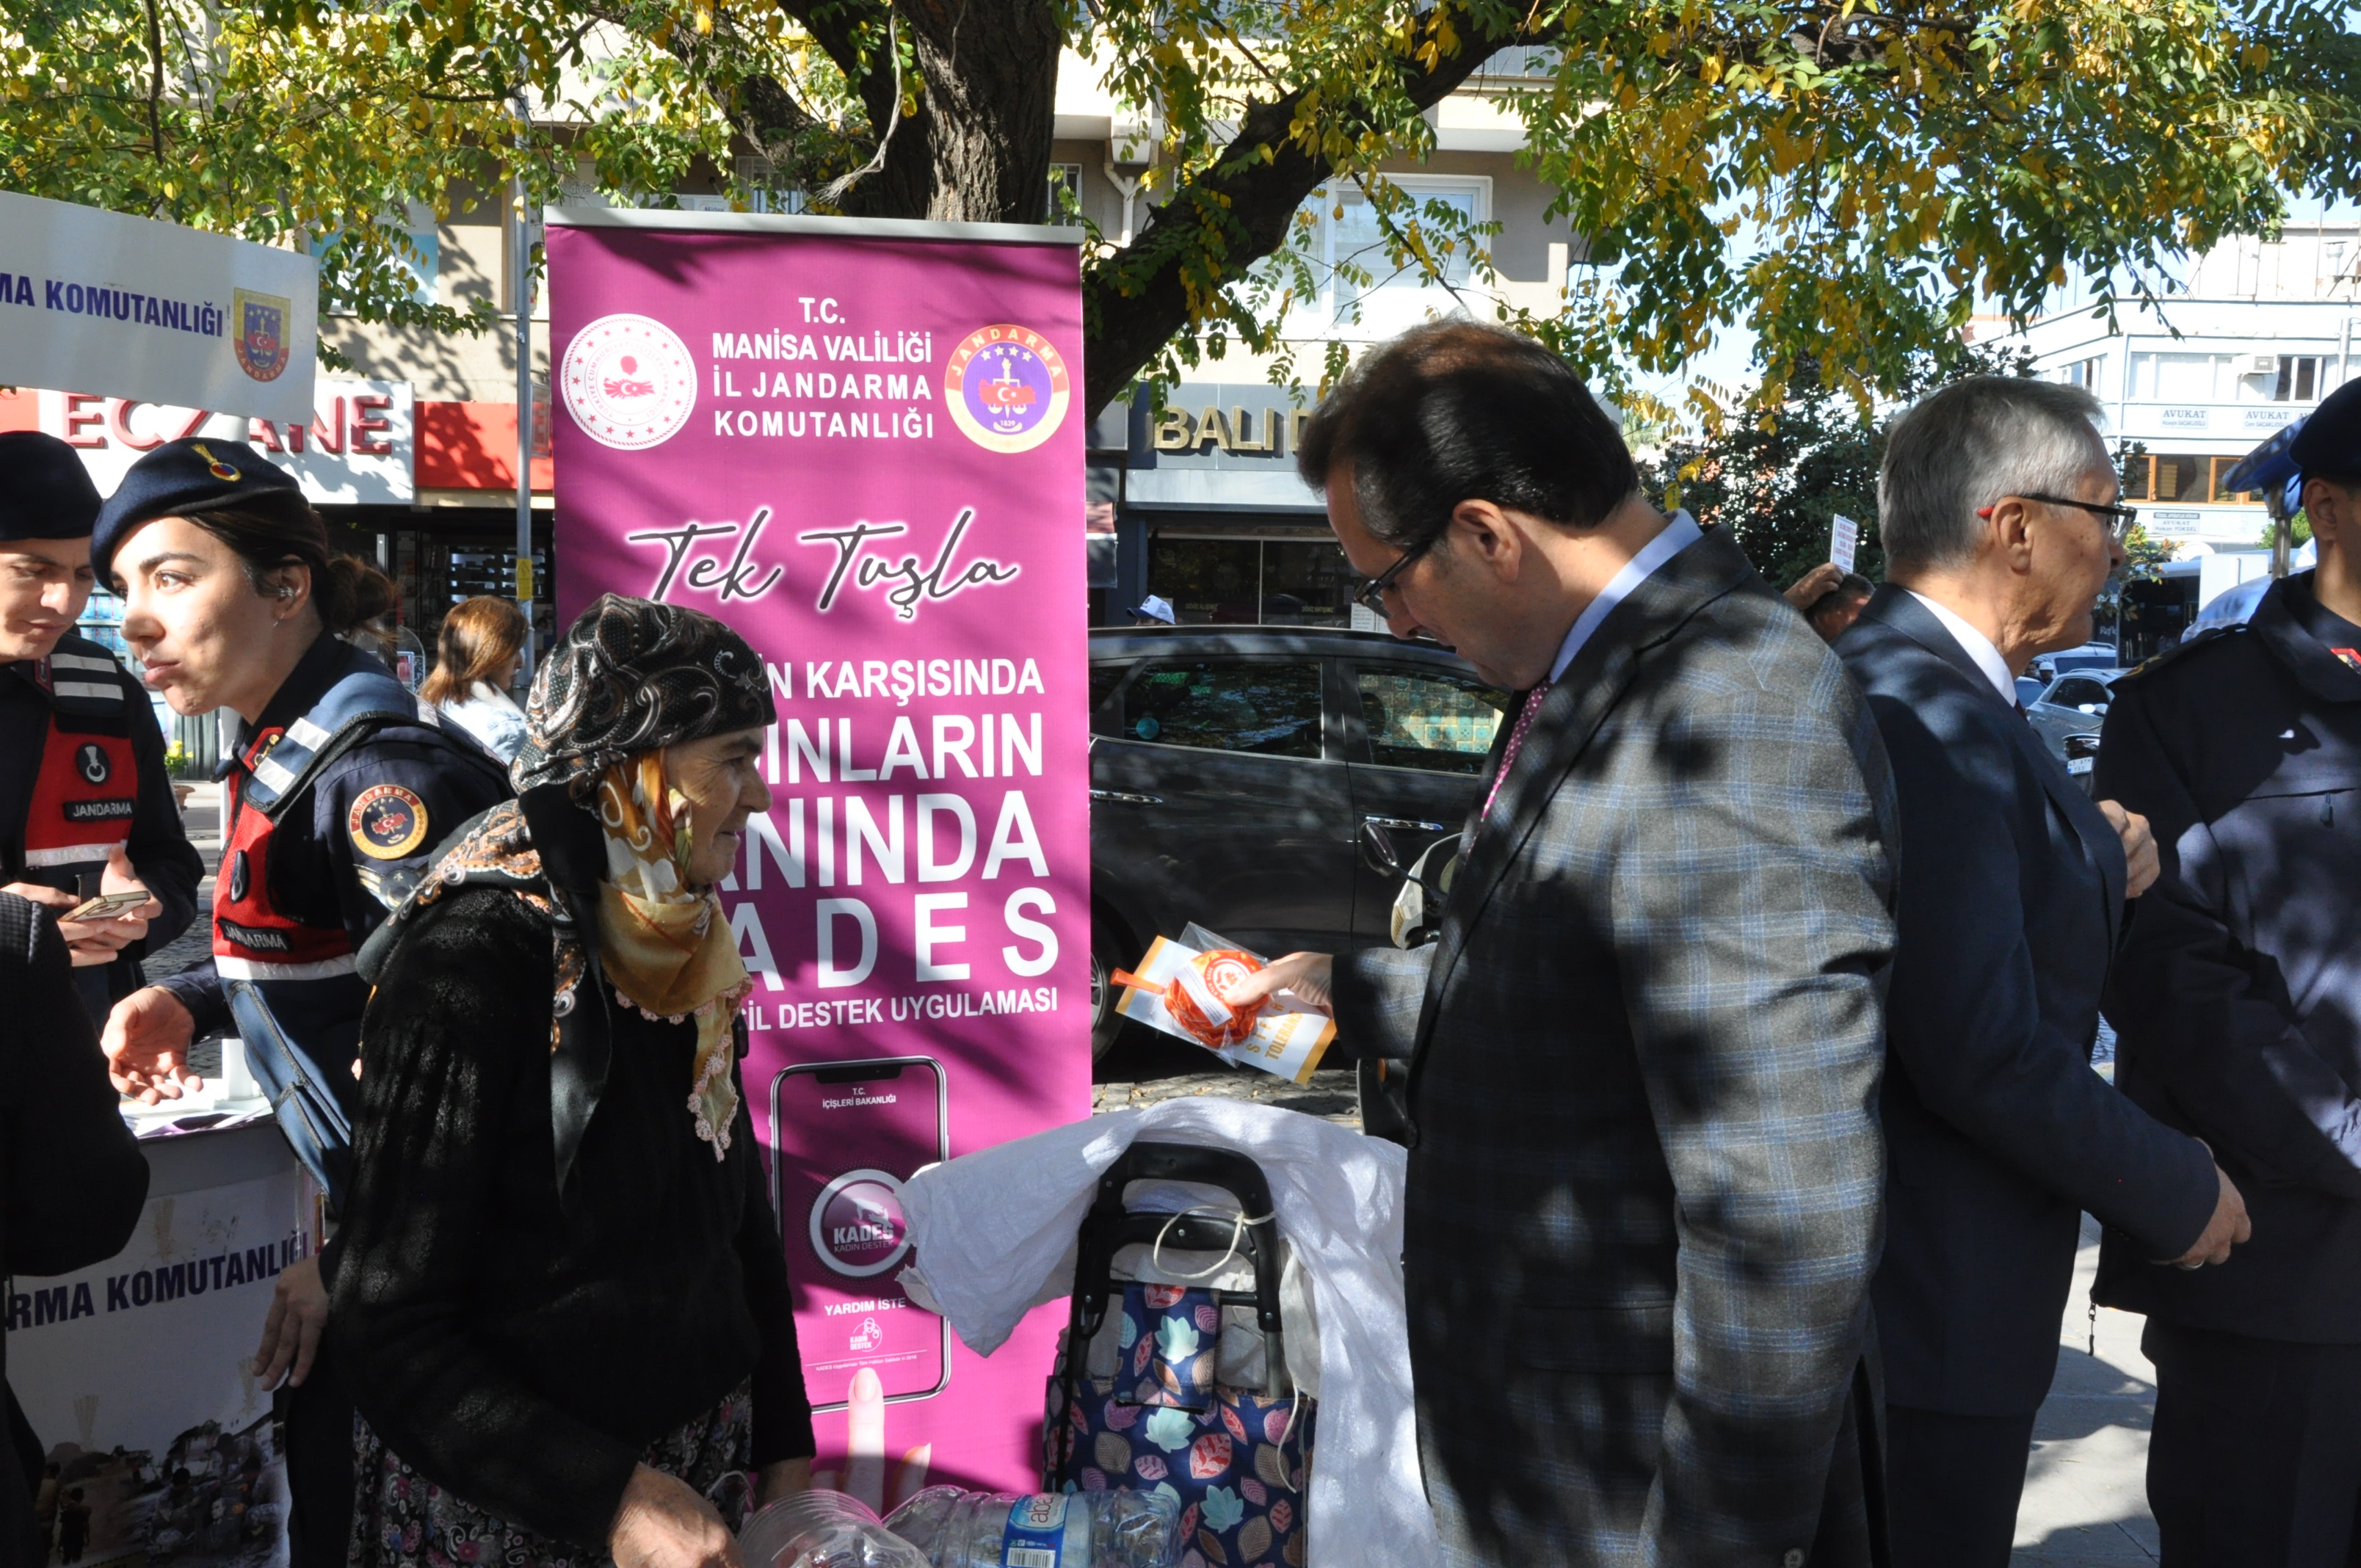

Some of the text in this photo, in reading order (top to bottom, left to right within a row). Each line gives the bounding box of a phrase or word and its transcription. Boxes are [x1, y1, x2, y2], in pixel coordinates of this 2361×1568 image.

[46, 280, 222, 337] KOMUTANLIĞI
[798, 297, 846, 324] T.C.
[712, 327, 932, 363] MANİSA VALİLİĞİ
[951, 328, 1062, 378] JANDARMA
[714, 364, 932, 400] İL JANDARMA
[714, 406, 933, 439] KOMUTANLIĞI
[2163, 410, 2207, 418] AVUKAT
[2246, 411, 2289, 419] AVUKAT
[628, 508, 1018, 619] Tek Tuşla
[807, 658, 1045, 706] KARŞISINDA
[754, 712, 1043, 785] INLARIN
[73, 802, 133, 817] JANDARMA
[718, 790, 1050, 891] NINDA
[779, 998, 884, 1029] DESTEK
[891, 987, 1058, 1023] UYGULAMASI
[822, 1093, 896, 1109] İÇİŞLERİ BAKANLIĞI
[852, 1087, 866, 1095] T.C.
[834, 1223, 893, 1244] KADES
[834, 1240, 893, 1252] KADIN DESTEK
[107, 1230, 308, 1313] KOMUTANLIĞI
[824, 1297, 906, 1316] YARDIM İSTE
[849, 1335, 868, 1343] KADIN
[849, 1342, 872, 1351] DESTEK
